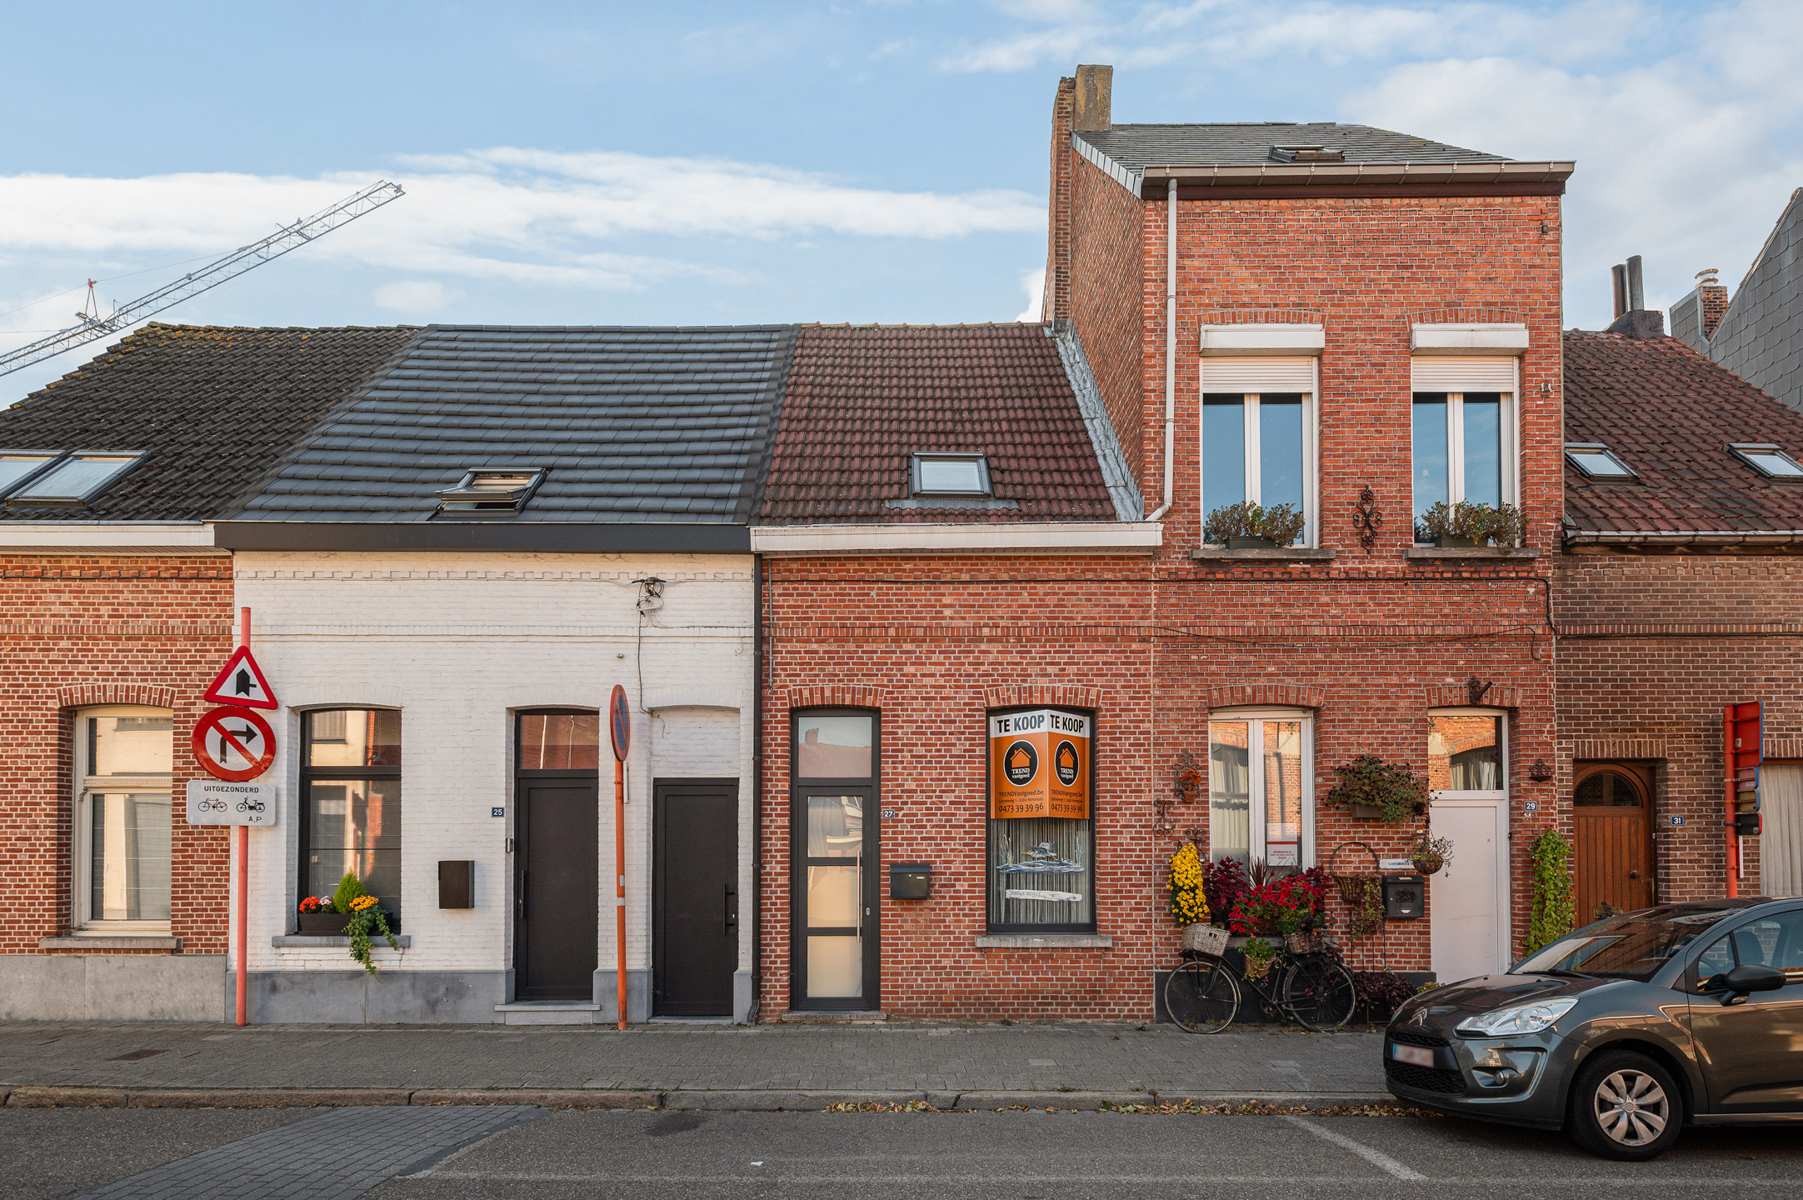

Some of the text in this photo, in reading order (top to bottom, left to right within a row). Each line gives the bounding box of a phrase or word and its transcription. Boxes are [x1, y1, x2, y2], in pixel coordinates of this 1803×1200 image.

[997, 714, 1045, 733] TE KOOP
[1050, 714, 1084, 733] TE KOOP
[203, 785, 260, 793] UITGEZONDERD
[998, 802, 1044, 813] 0473 39 39 96
[1051, 803, 1063, 812] 0473
[1063, 804, 1070, 813] 39
[1070, 804, 1077, 813] 39
[1526, 802, 1536, 810] 29
[493, 808, 503, 816] 25
[884, 810, 894, 818] 27
